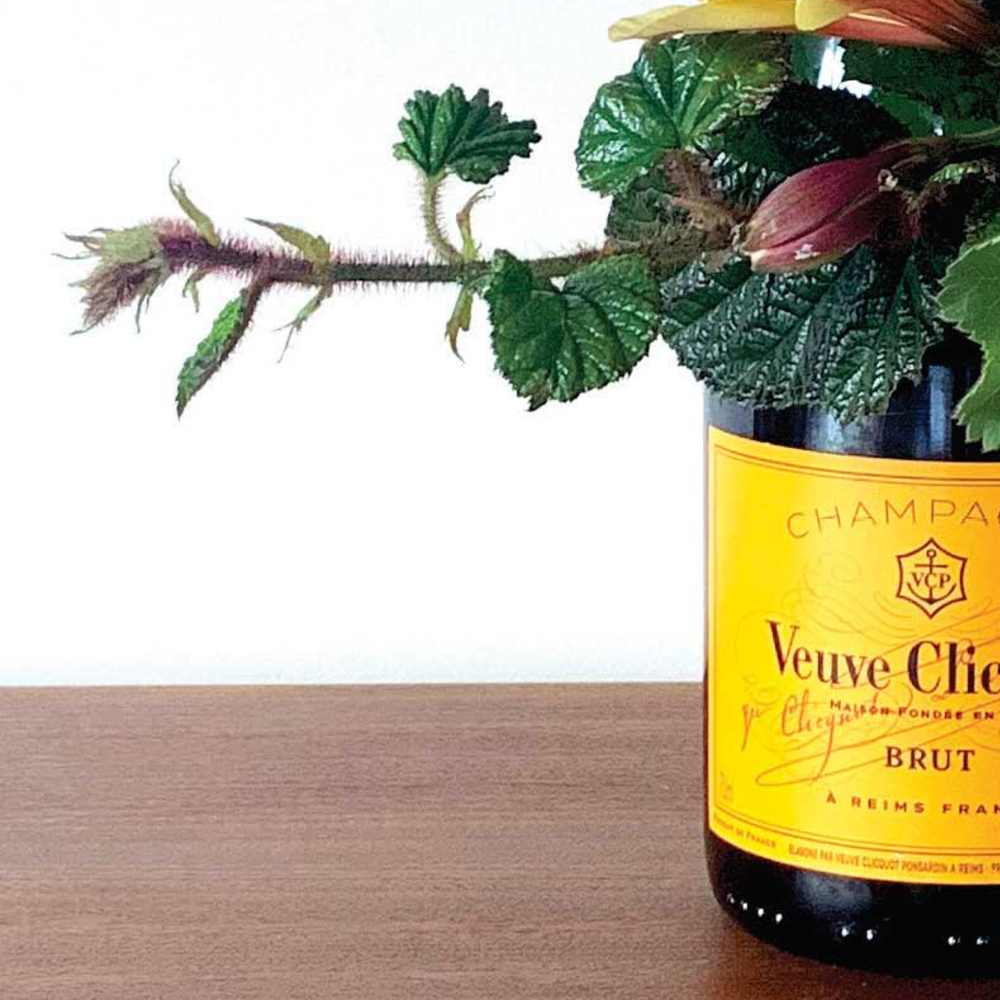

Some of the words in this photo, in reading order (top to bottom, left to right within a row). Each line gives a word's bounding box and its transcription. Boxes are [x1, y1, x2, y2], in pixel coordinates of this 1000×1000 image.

[767, 619, 891, 691] Veuve
[973, 708, 996, 721] EN
[884, 745, 977, 772] BRUT
[850, 795, 926, 814] REIMS
